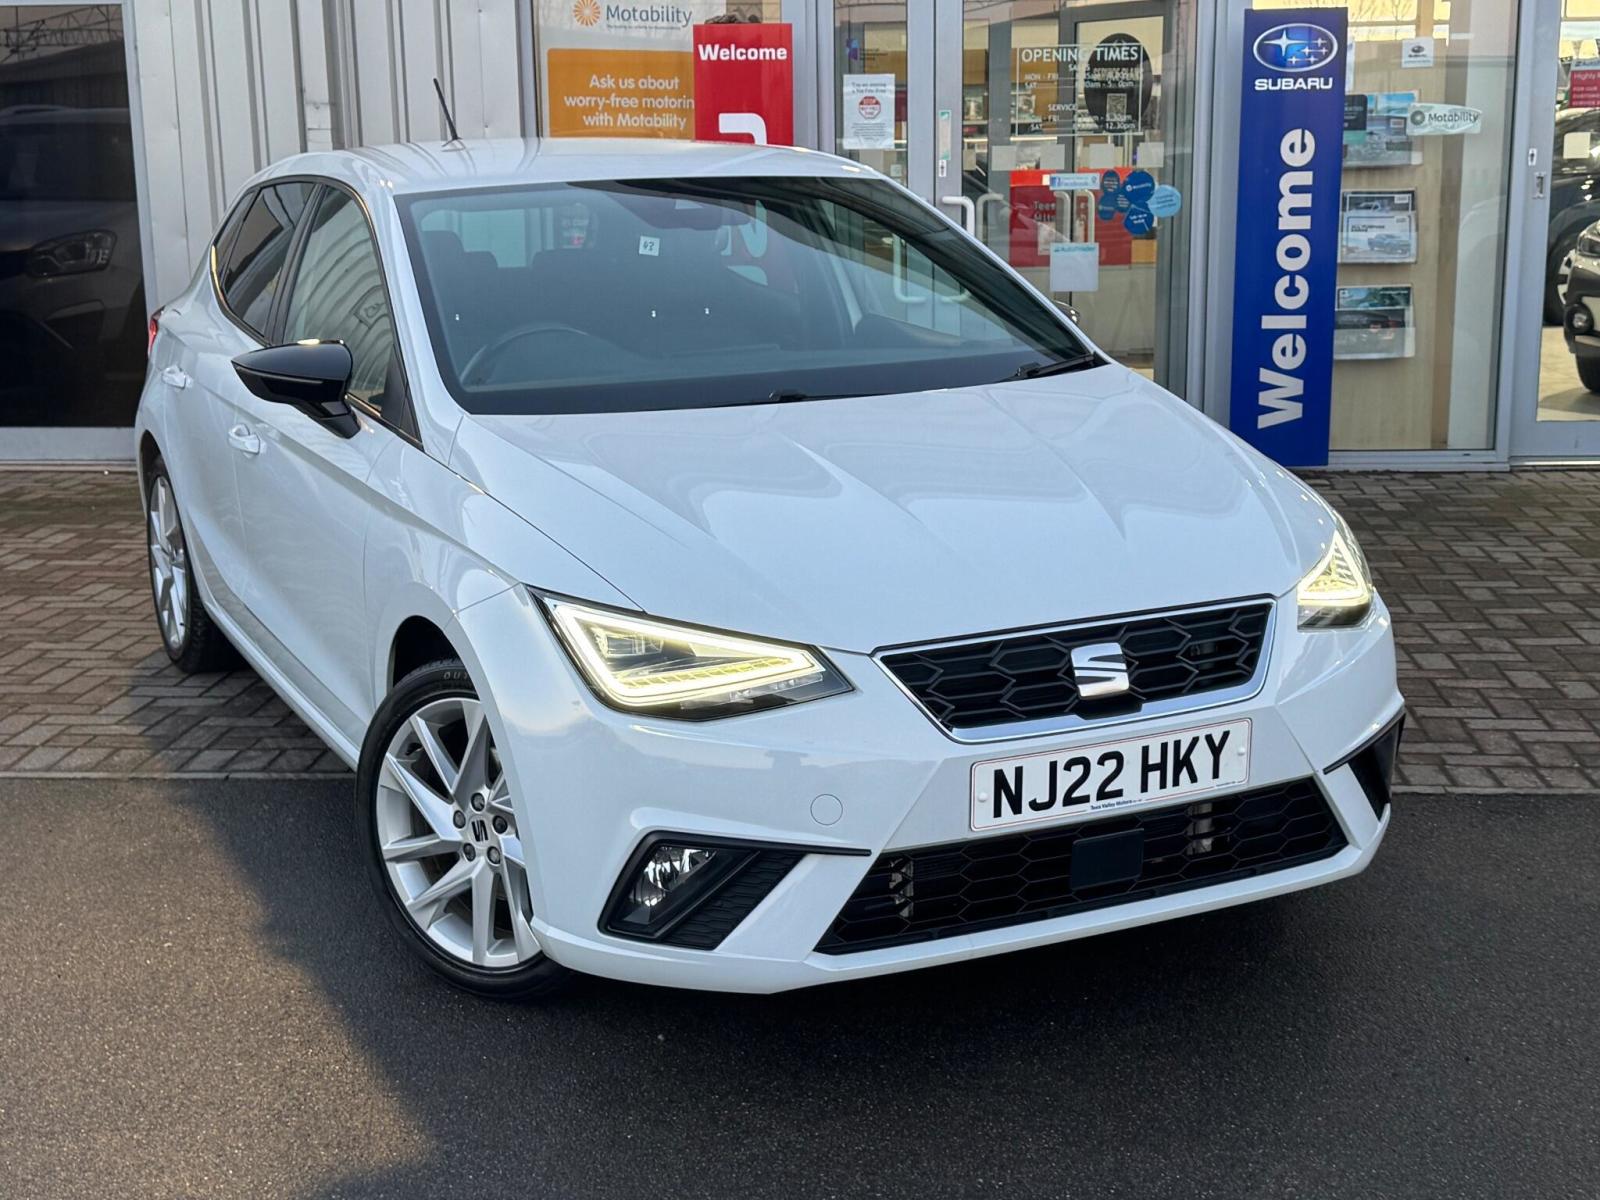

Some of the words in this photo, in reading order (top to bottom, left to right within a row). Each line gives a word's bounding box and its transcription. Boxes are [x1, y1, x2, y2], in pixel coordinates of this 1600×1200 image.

[606, 4, 693, 27] Motability
[698, 44, 787, 61] Welcome
[1021, 48, 1088, 63] OPENING
[1096, 46, 1138, 61] TIMES
[589, 74, 615, 89] Ask
[619, 77, 635, 89] us
[638, 75, 680, 91] about
[1254, 77, 1333, 91] SUBARU
[564, 94, 639, 110] worry-free
[642, 96, 694, 109] motorin
[583, 113, 613, 127] with
[617, 113, 687, 130] Motability
[1428, 111, 1479, 123] Motability
[1257, 128, 1315, 430] Welcome
[993, 750, 1124, 818] NJ22
[1140, 730, 1231, 793] HKY
